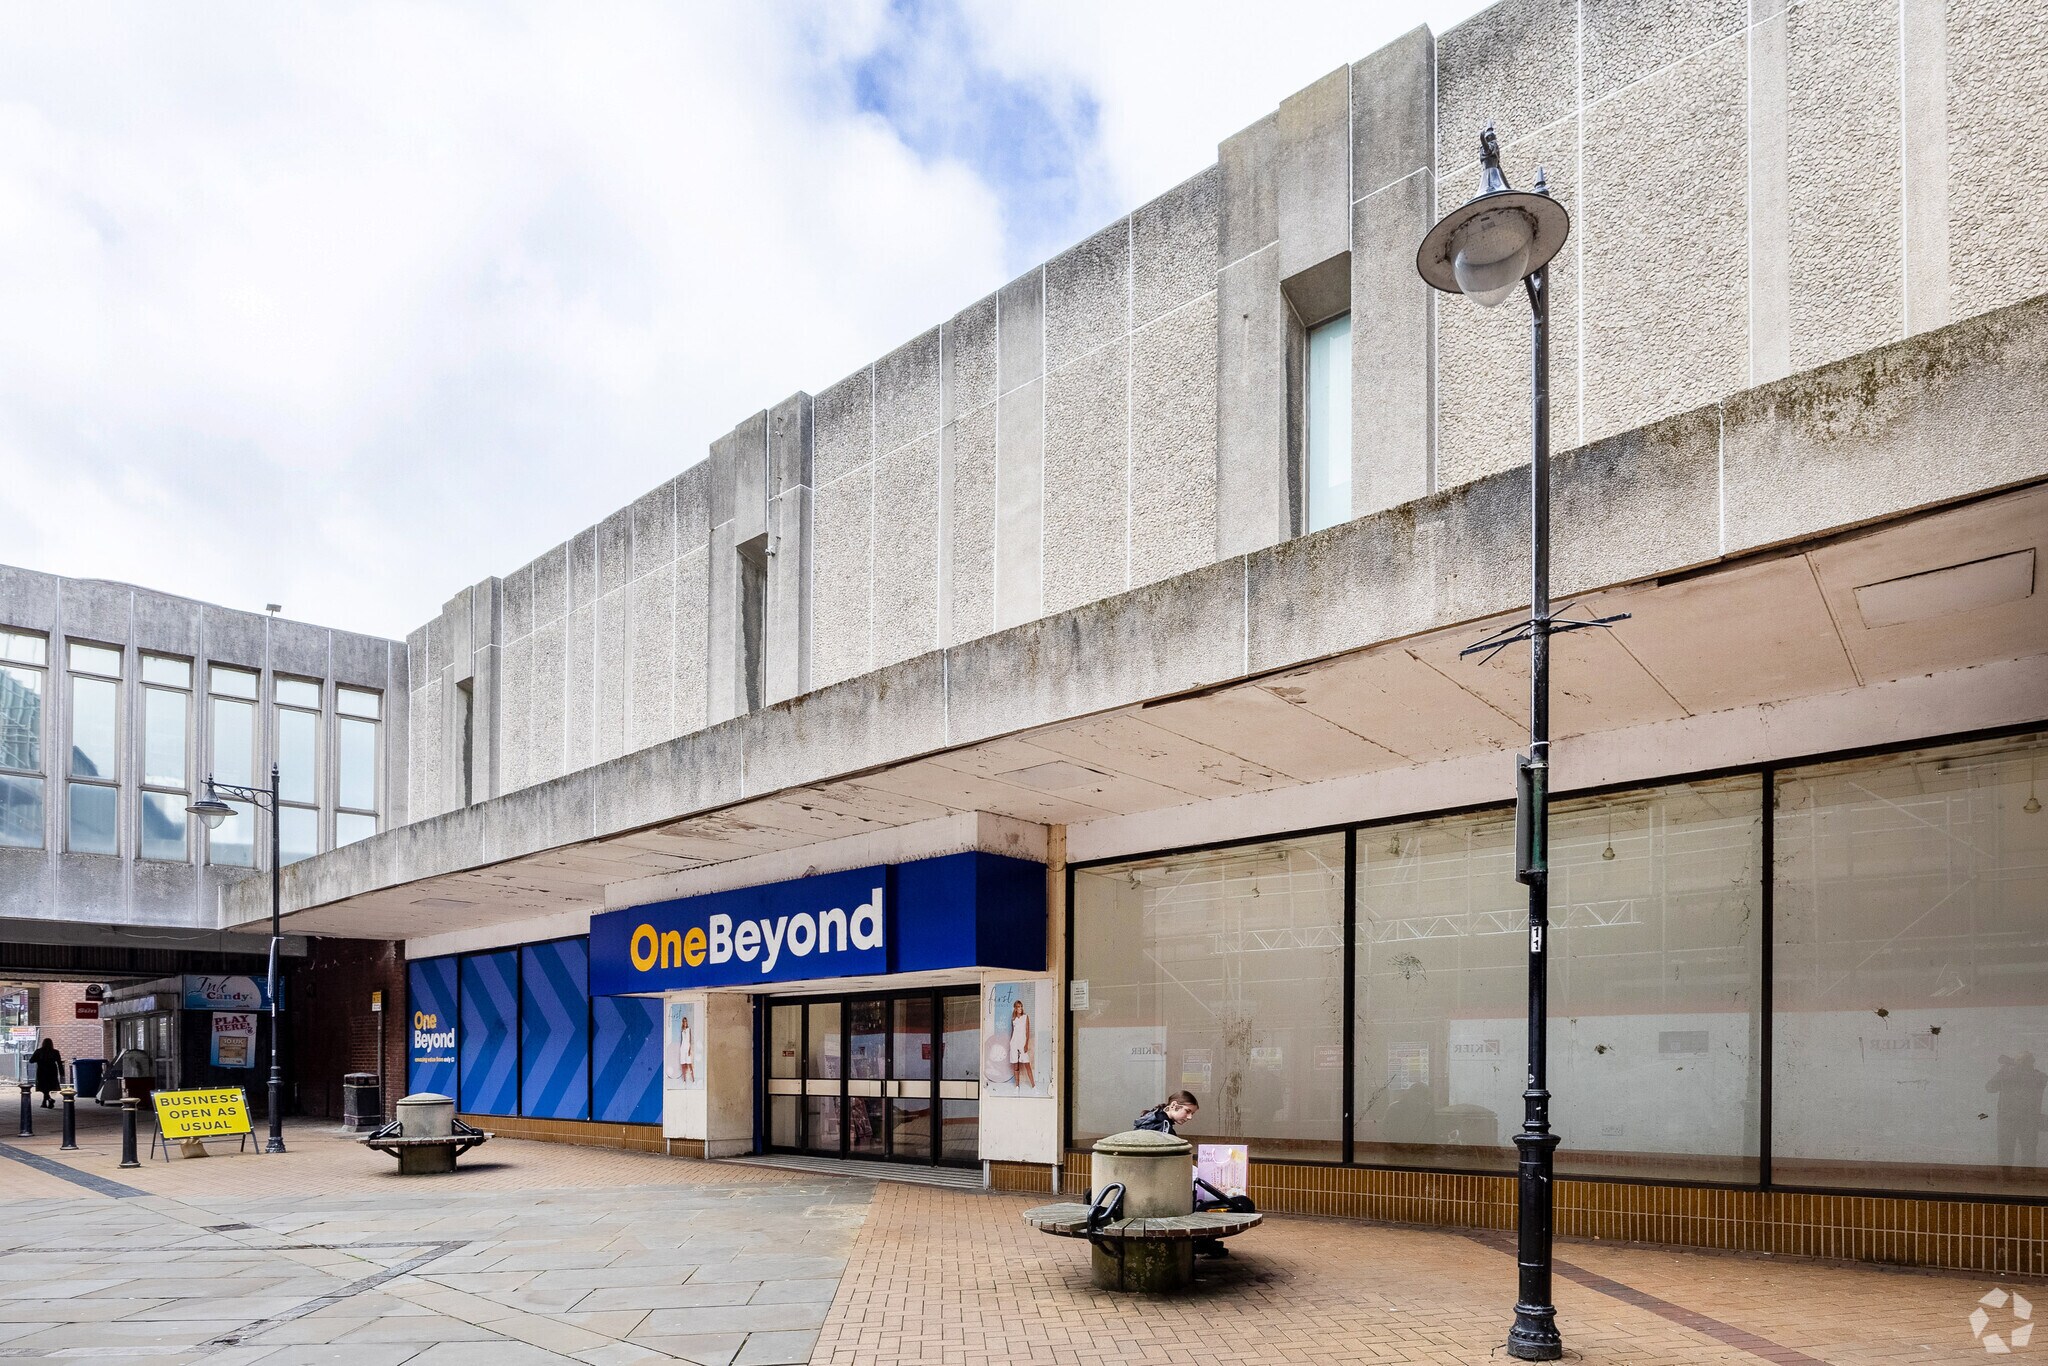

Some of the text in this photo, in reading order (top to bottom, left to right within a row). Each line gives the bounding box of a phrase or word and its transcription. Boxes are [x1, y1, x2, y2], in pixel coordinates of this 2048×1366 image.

[206, 992, 250, 1001] Candy
[988, 986, 1014, 1015] first
[214, 1015, 249, 1026] PLAY
[414, 1011, 437, 1030] One
[215, 1022, 251, 1032] HERE!
[414, 1028, 455, 1053] Beyond
[159, 1094, 239, 1107] BUSINESS
[169, 1107, 237, 1119] OPEN AS
[180, 1120, 233, 1131] USUAL
